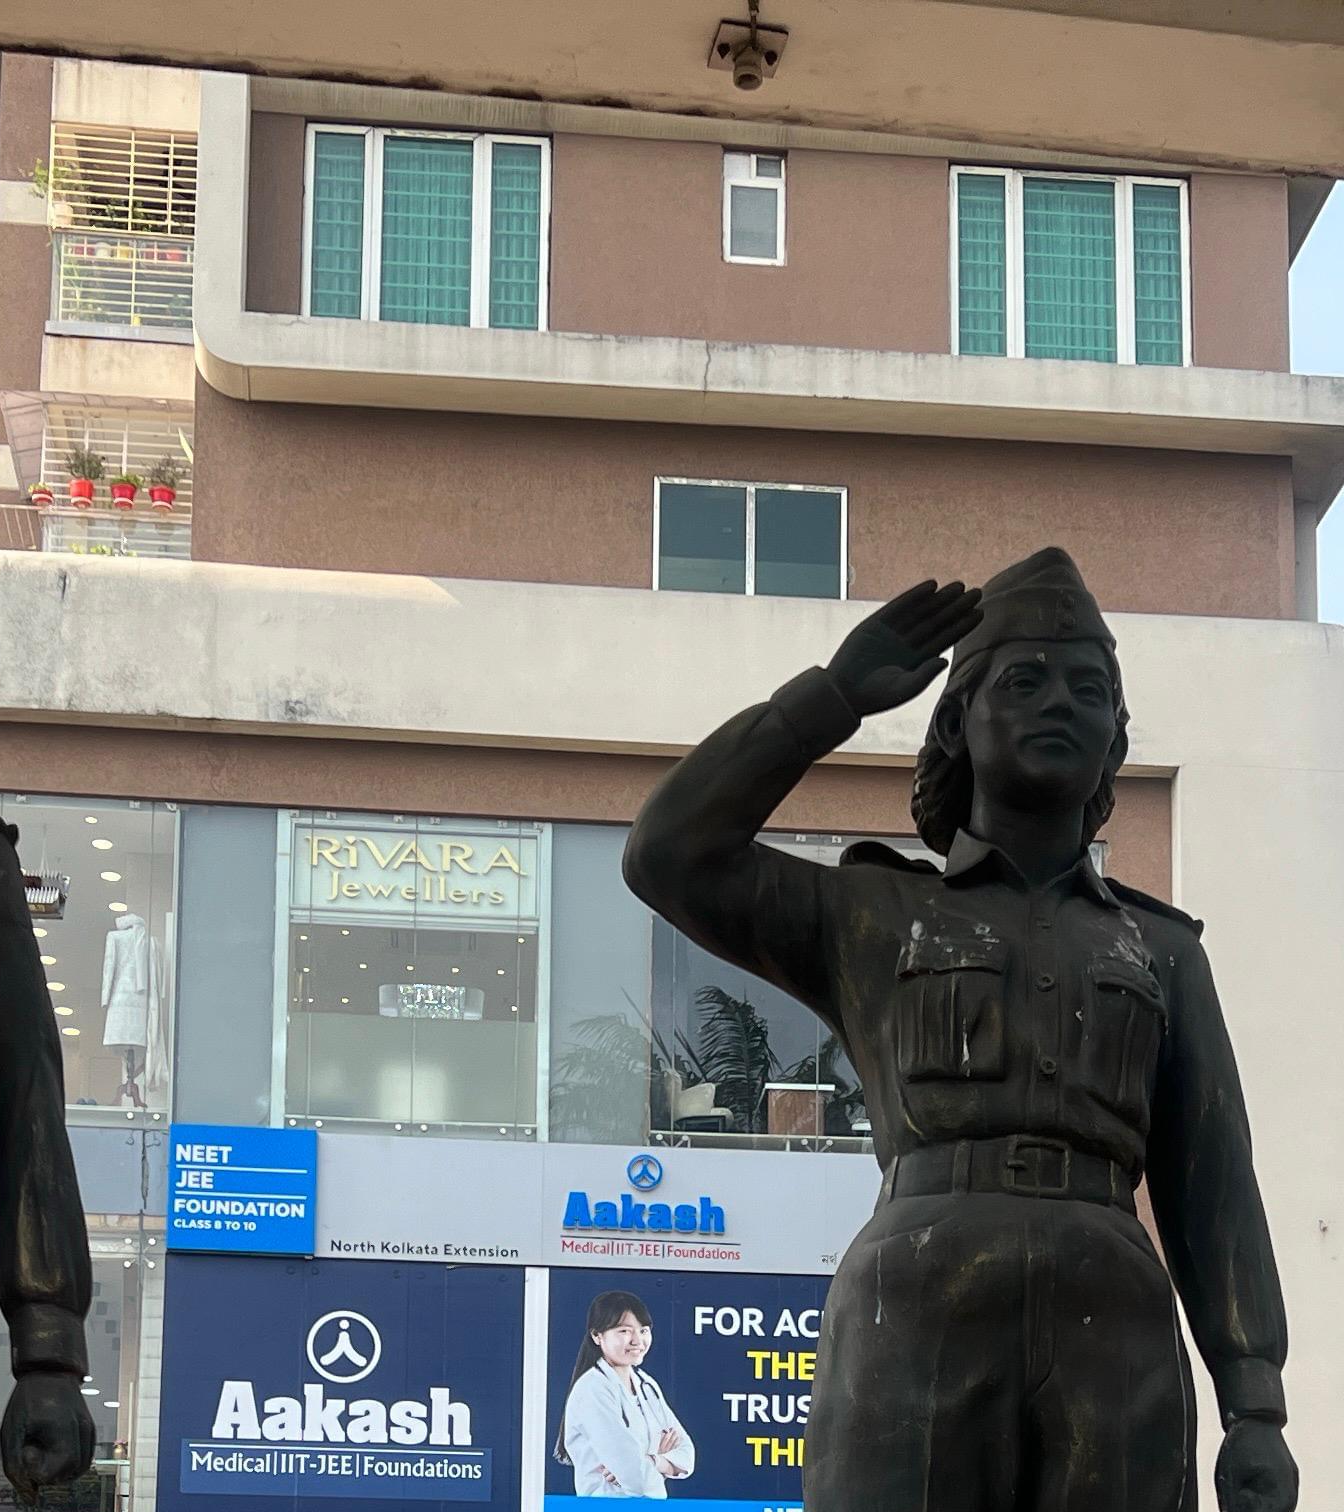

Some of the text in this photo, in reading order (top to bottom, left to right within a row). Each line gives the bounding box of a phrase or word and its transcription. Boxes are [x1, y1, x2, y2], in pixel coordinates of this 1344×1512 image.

[328, 870, 504, 904] Jewellers
[175, 1144, 233, 1164] NEET
[175, 1171, 214, 1189] JEE
[174, 1199, 305, 1218] FOUNDATION
[562, 1191, 725, 1236] Aakash
[174, 1219, 256, 1232] CLASS 8 TO 10
[330, 1239, 519, 1258] North Kolkata Extension
[694, 1306, 825, 1338] FOR AC
[746, 1351, 817, 1381] THE
[212, 1380, 472, 1446] Aakash
[746, 1437, 805, 1467] TH
